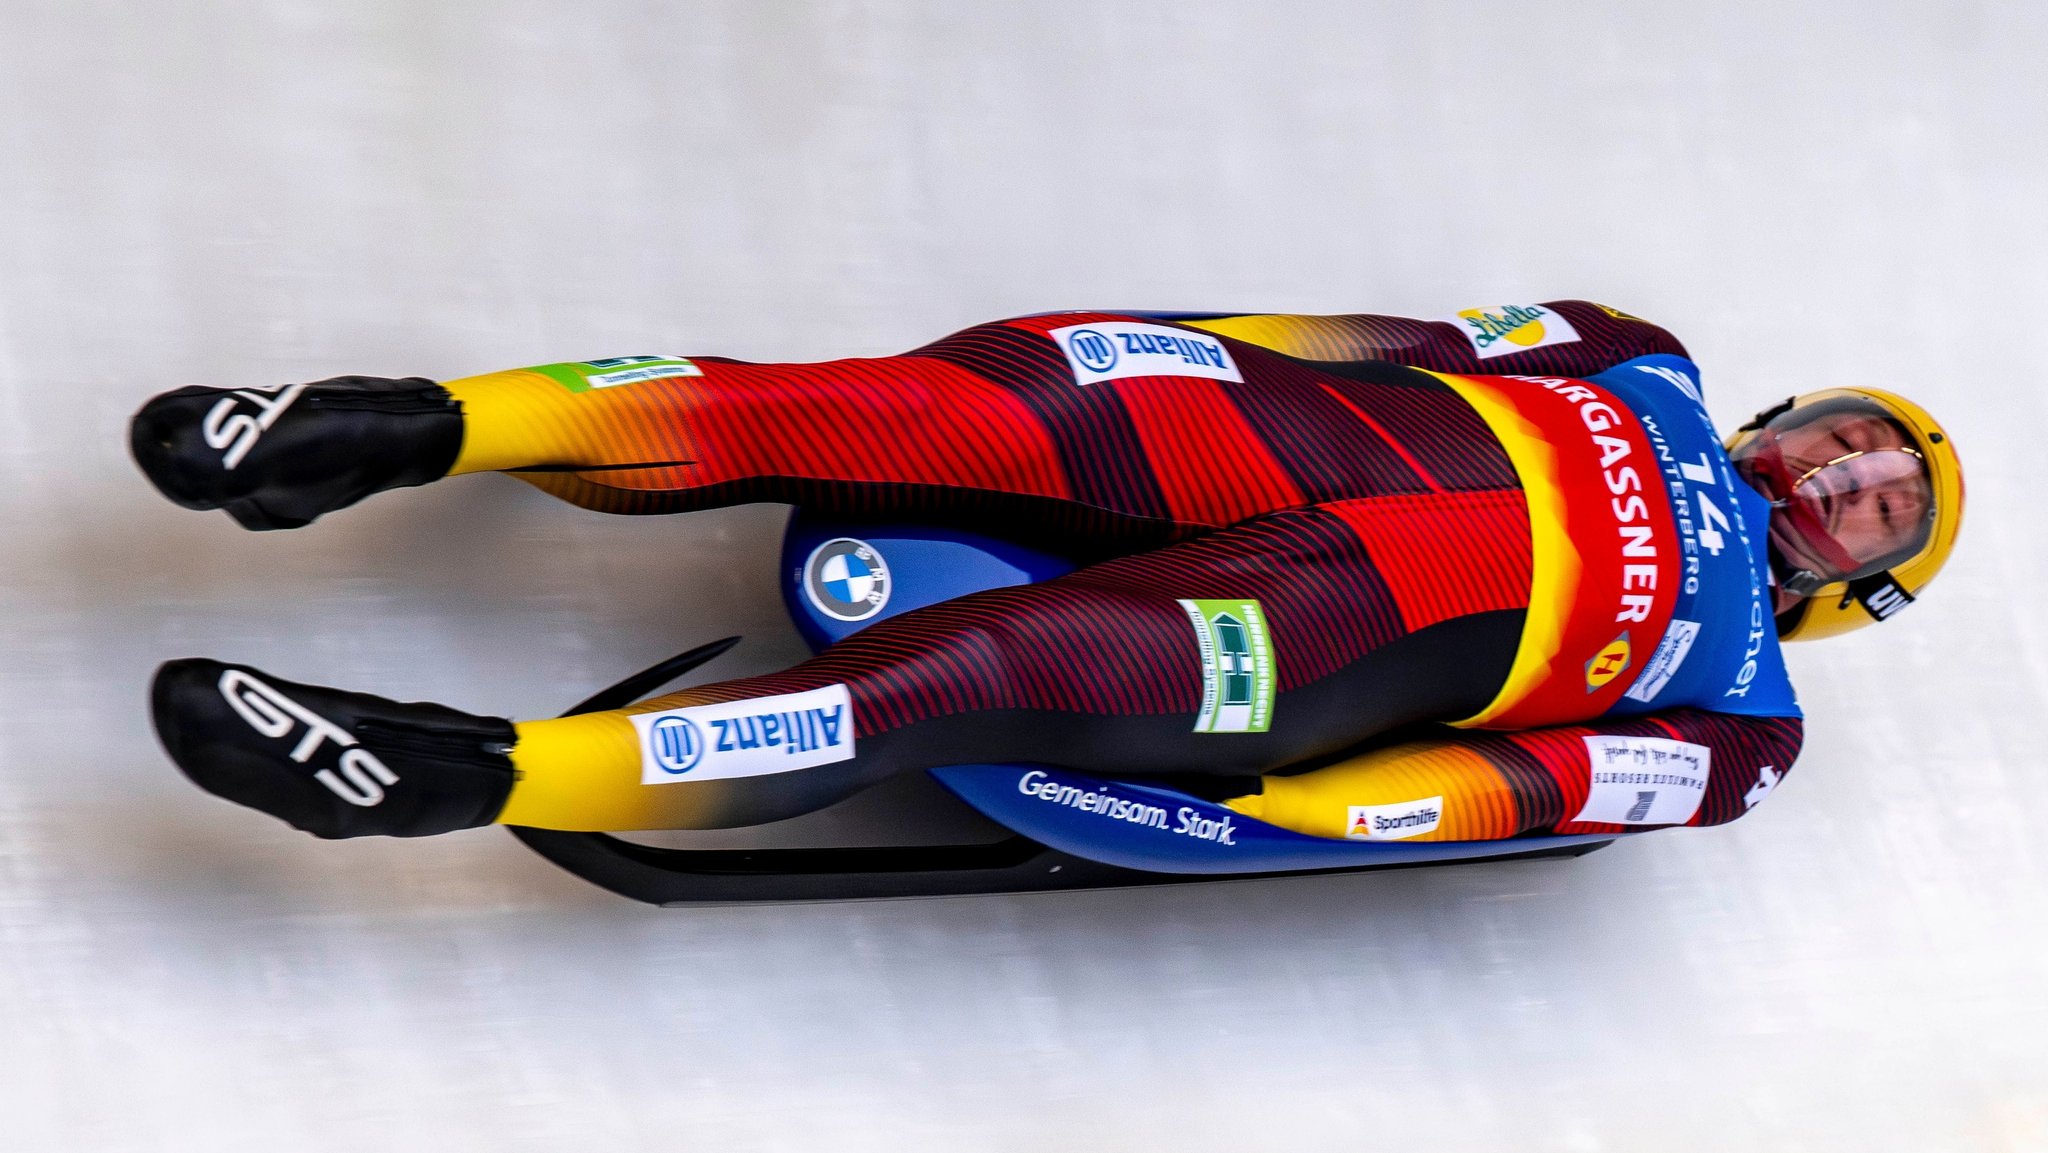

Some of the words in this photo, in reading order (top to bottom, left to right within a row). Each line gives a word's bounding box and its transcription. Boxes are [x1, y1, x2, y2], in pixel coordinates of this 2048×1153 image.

[1114, 333, 1229, 370] Allianz
[1466, 304, 1546, 348] Libella
[203, 384, 305, 470] TS
[1641, 414, 1700, 595] WINTERBERG
[1678, 451, 1732, 557] 14
[217, 669, 401, 807] GTS
[707, 704, 845, 755] Allianz
[1374, 807, 1438, 833] Sporthilfe
